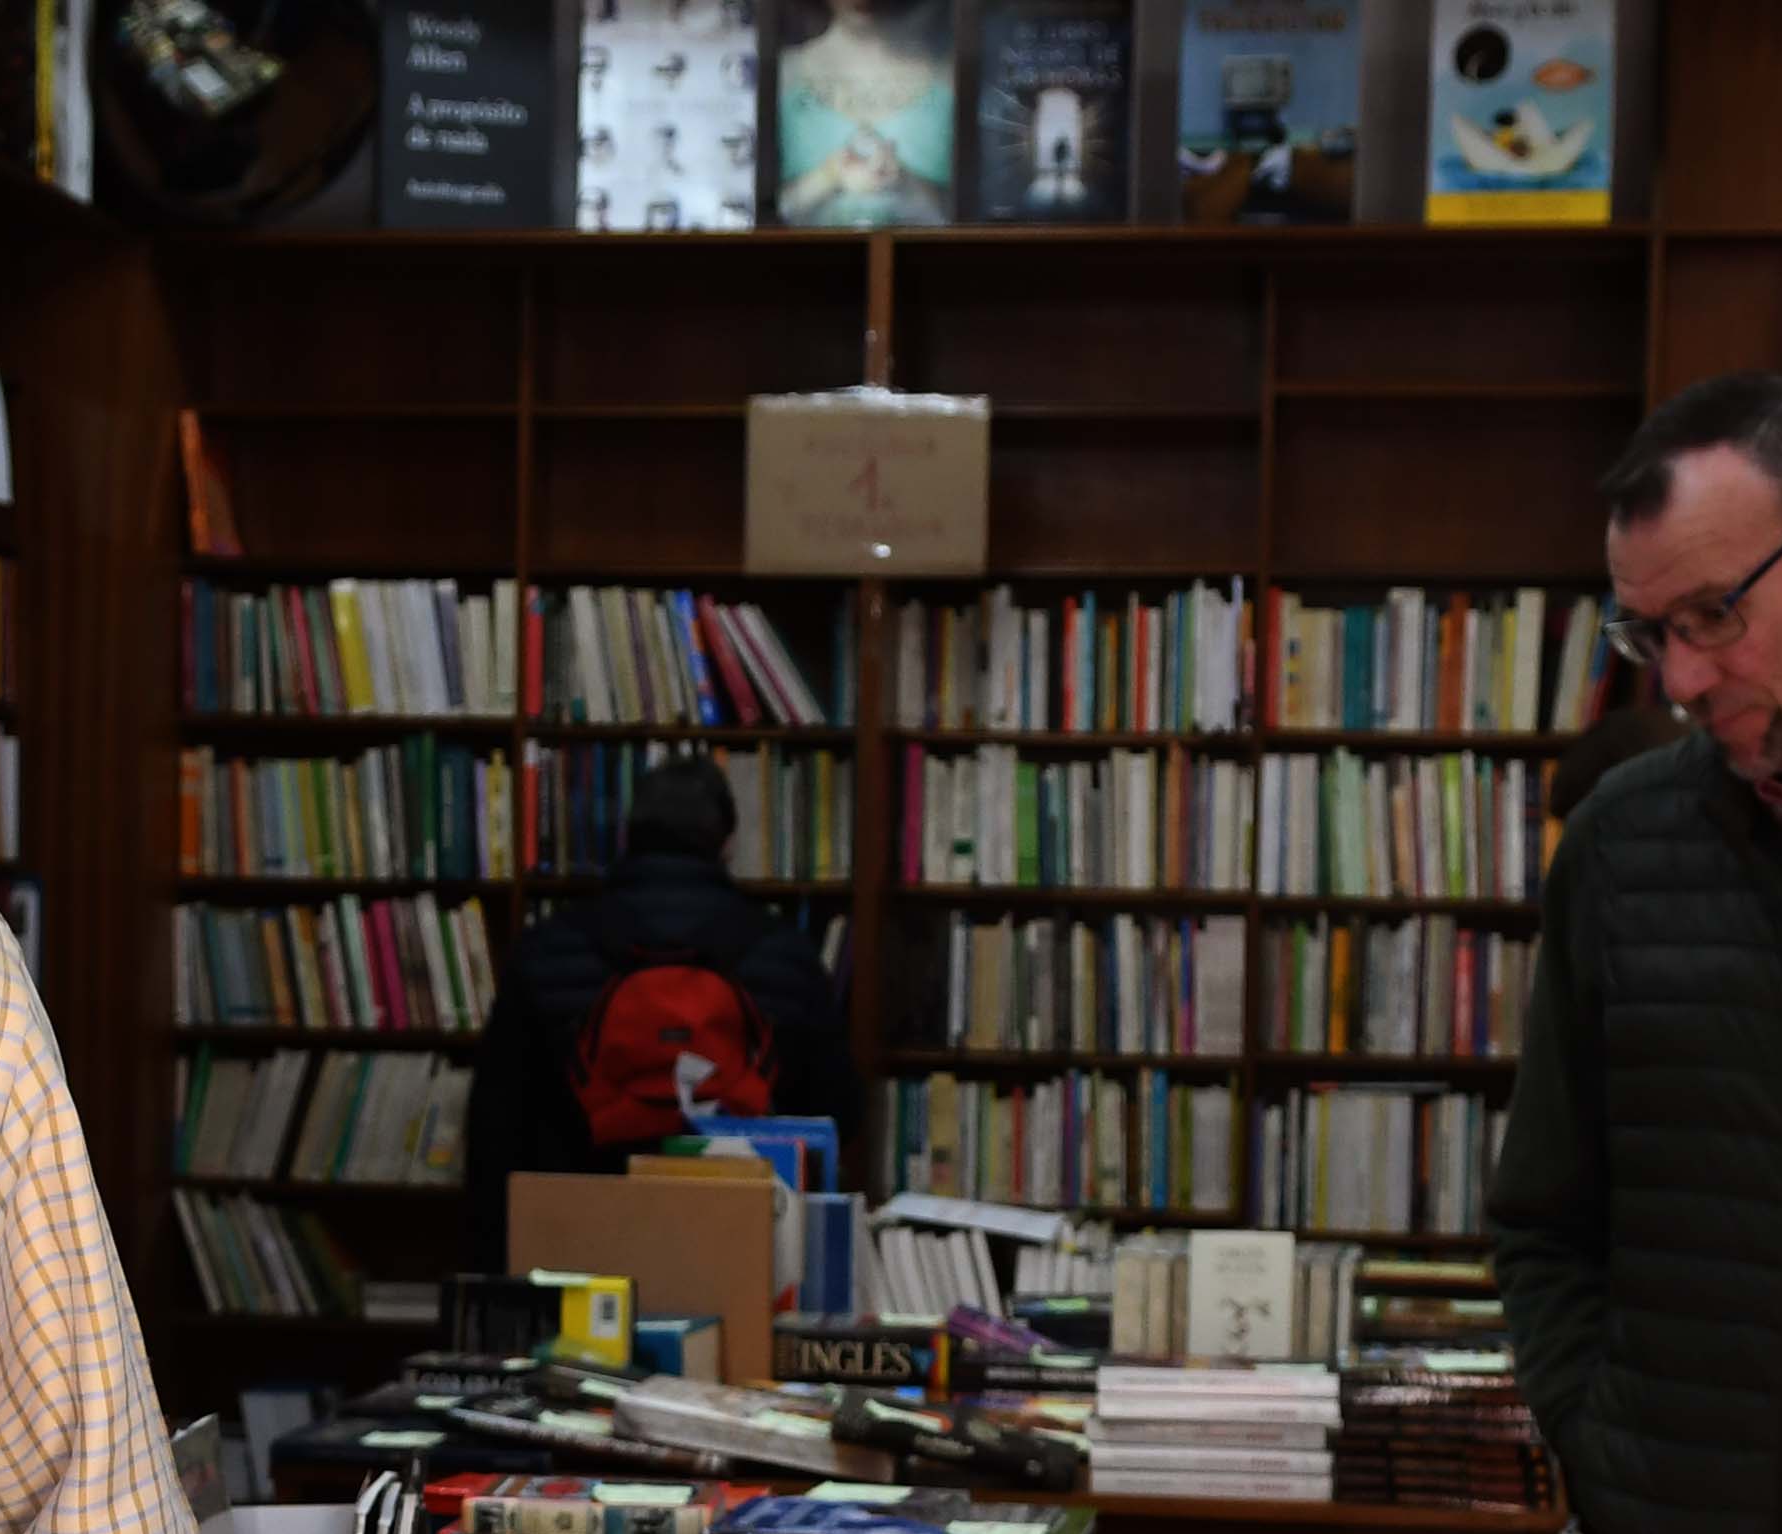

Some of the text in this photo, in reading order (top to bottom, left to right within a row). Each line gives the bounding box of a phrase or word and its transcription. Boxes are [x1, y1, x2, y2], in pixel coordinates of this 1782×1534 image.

[405, 43, 468, 73] Allen
[406, 91, 425, 118] A
[404, 123, 431, 151] de
